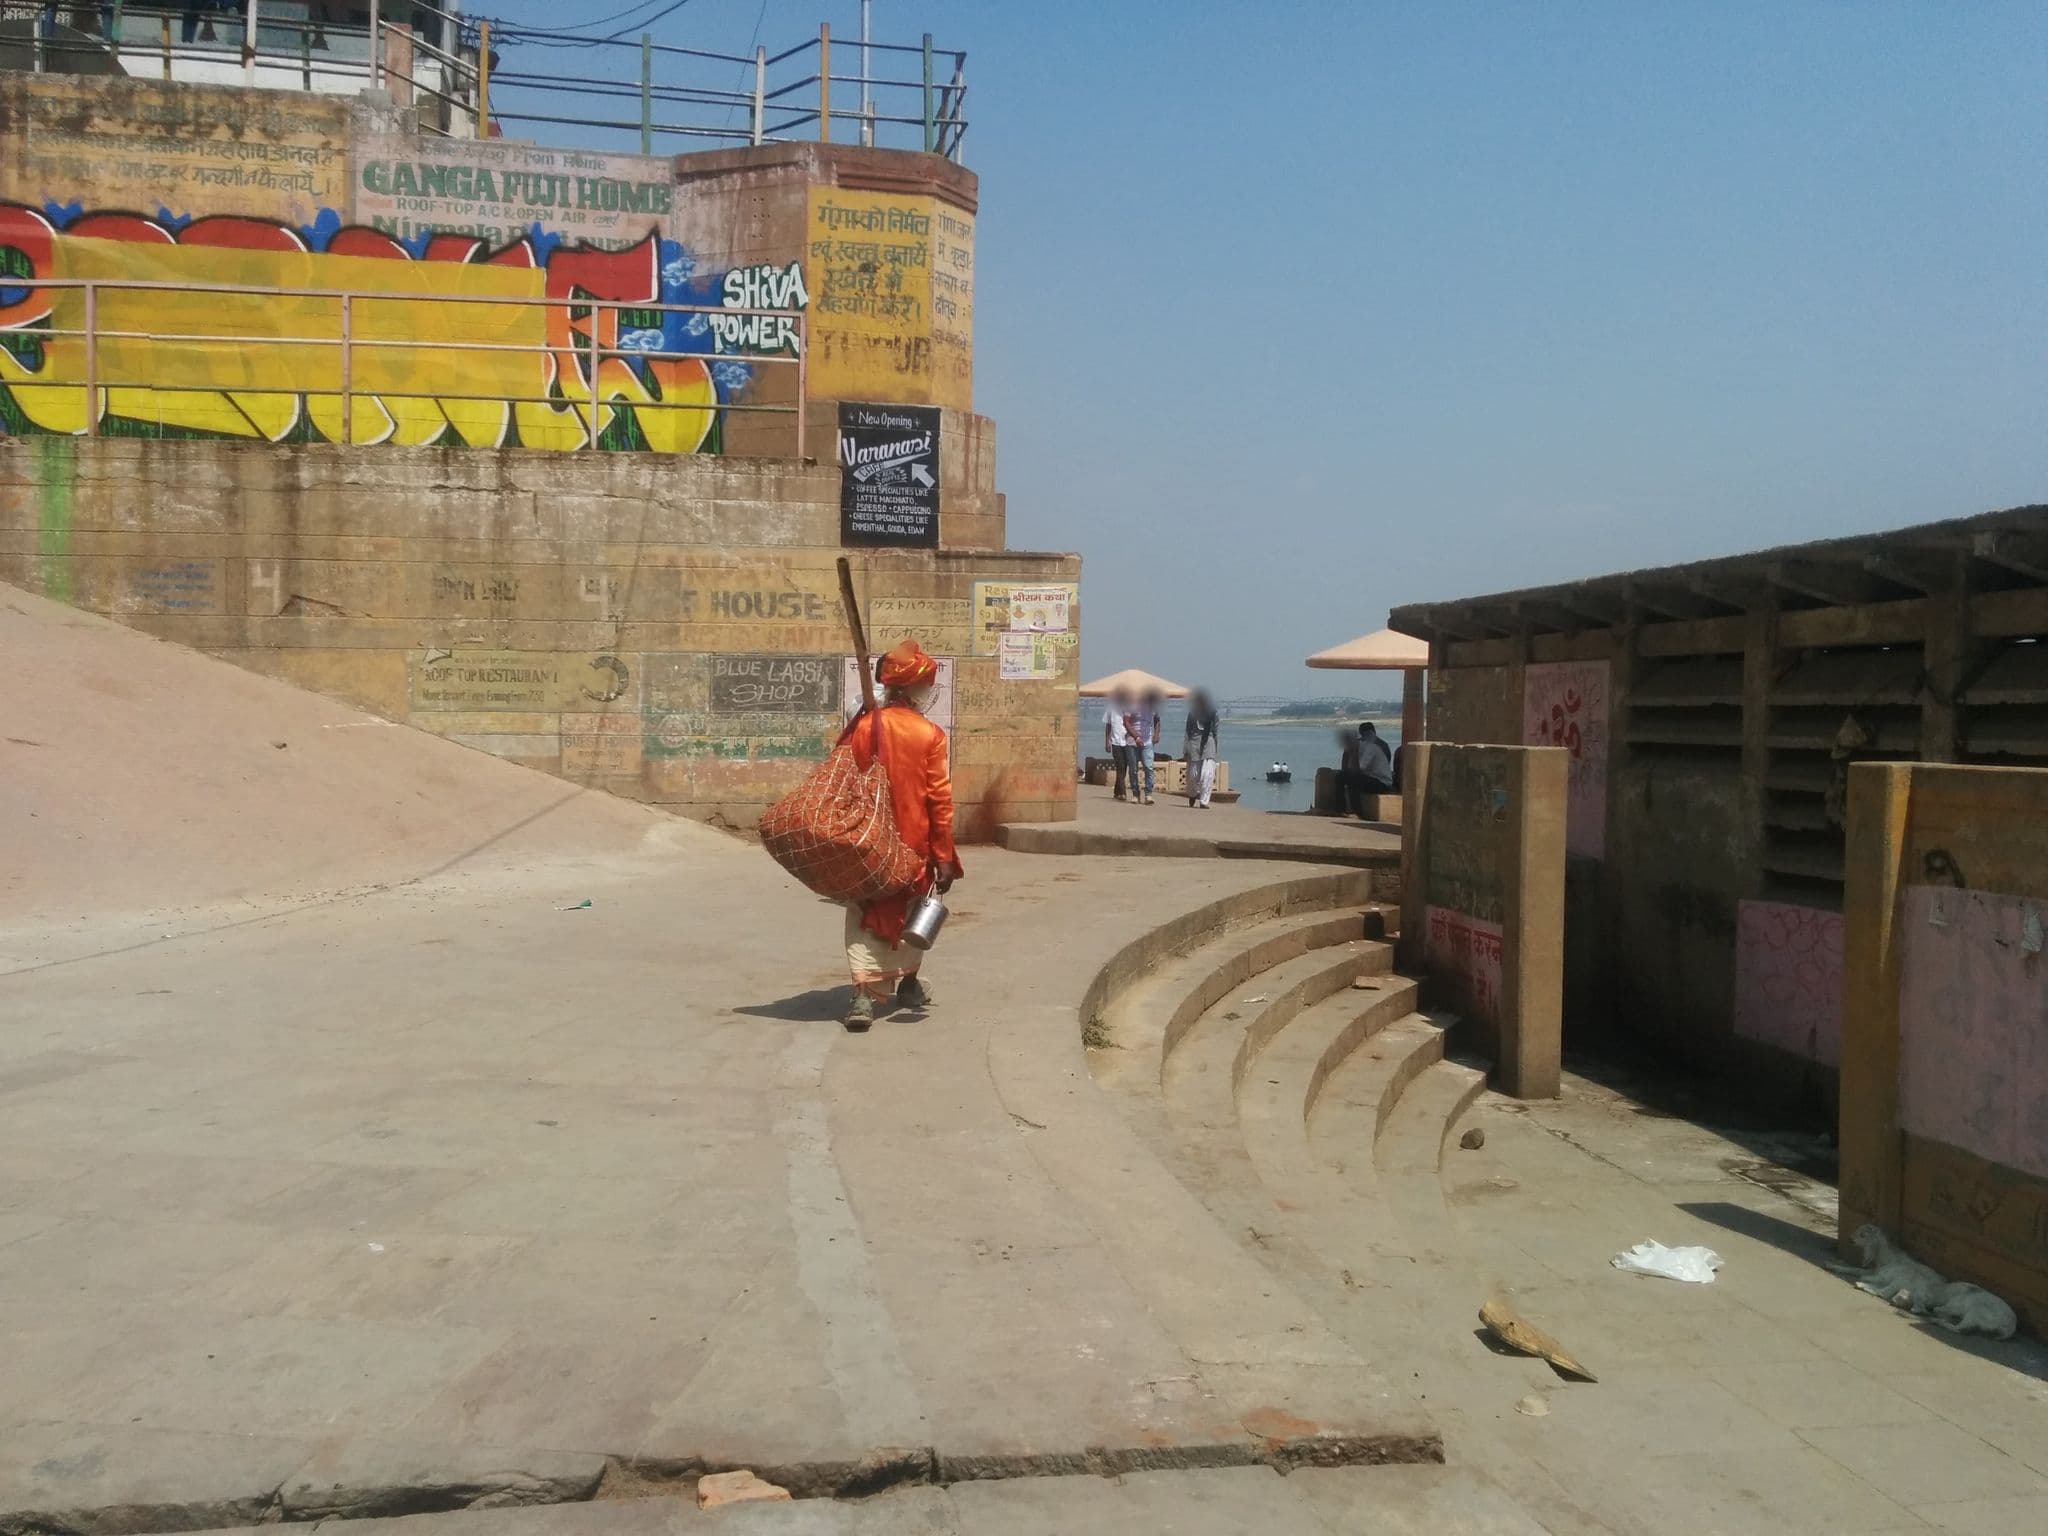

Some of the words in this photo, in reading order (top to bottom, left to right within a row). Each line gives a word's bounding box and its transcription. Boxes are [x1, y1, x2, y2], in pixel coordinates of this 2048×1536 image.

[362, 160, 499, 201] GANGA
[500, 171, 572, 208] FUJI
[576, 177, 671, 214] HOME
[397, 198, 473, 214] ROOF-TOP
[517, 207, 553, 221] OPEN
[561, 212, 586, 224] AIR
[709, 313, 800, 353] POWER
[858, 411, 880, 425] New
[881, 412, 913, 429] Opening
[842, 430, 931, 466] Varanasi
[857, 495, 878, 503] LATTE
[915, 487, 929, 497] LIKE
[916, 516, 928, 524] LIKE
[711, 590, 826, 620] HOUSE
[715, 659, 760, 677] BLUE
[730, 683, 804, 703] SHOP
